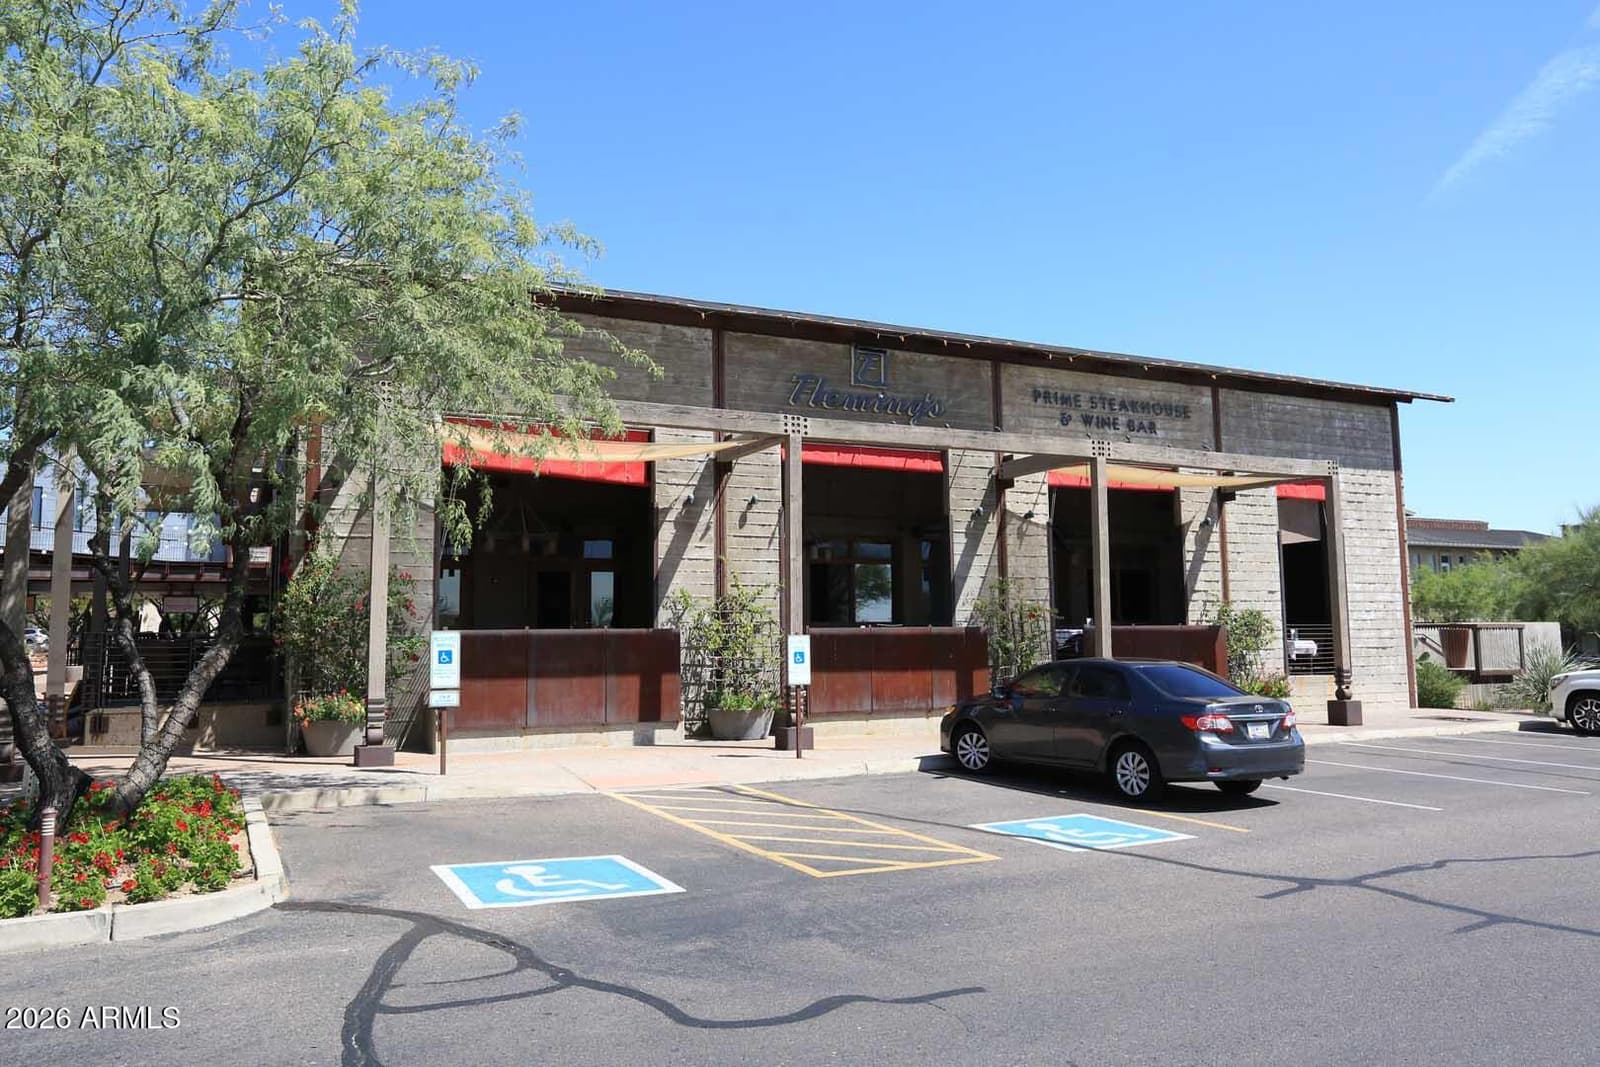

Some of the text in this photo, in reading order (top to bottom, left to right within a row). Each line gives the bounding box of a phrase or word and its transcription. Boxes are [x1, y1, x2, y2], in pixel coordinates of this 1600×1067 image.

[788, 373, 945, 426] Fleming's
[1032, 389, 1192, 419] PRIME STEAKHOUSE
[1060, 412, 1158, 435] & WINE BAR
